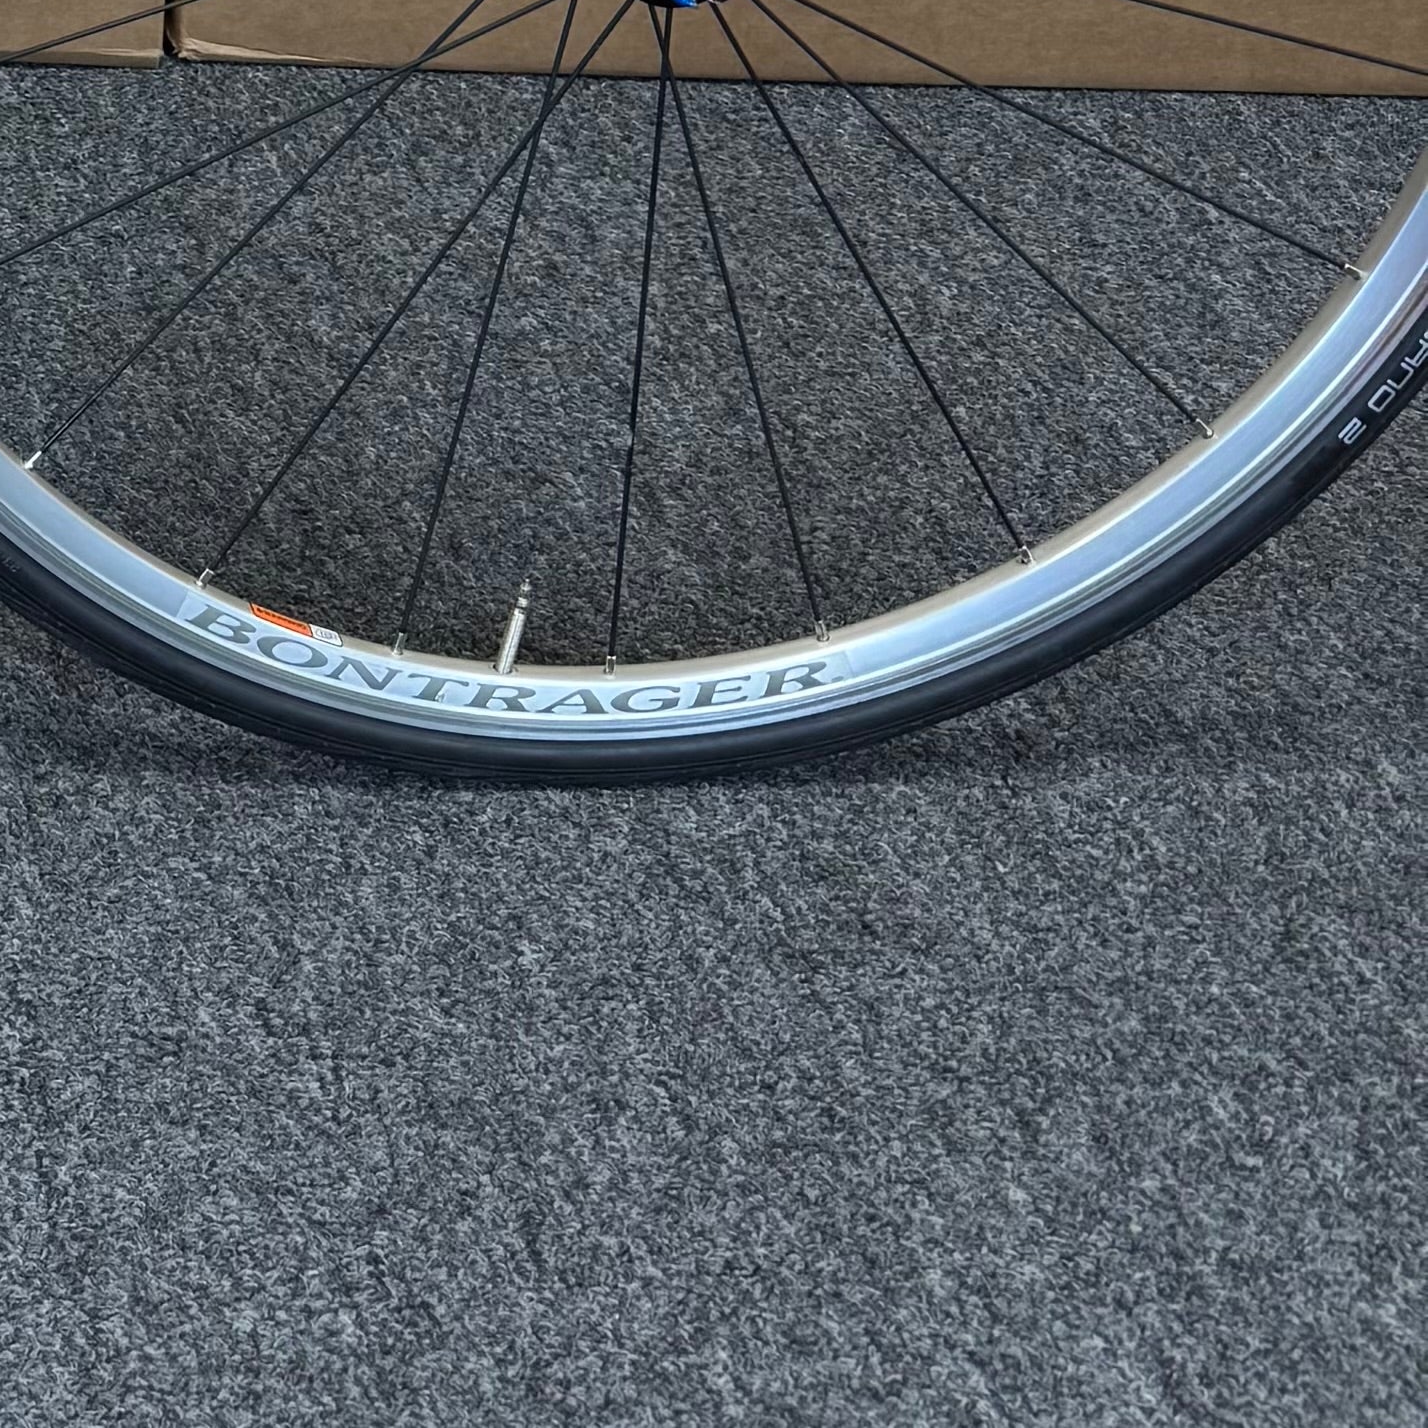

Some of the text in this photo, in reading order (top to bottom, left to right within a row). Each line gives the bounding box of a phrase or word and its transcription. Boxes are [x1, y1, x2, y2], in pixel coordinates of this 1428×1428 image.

[1338, 334, 1428, 445] ANO 2
[181, 603, 836, 715] BONTRAGER
